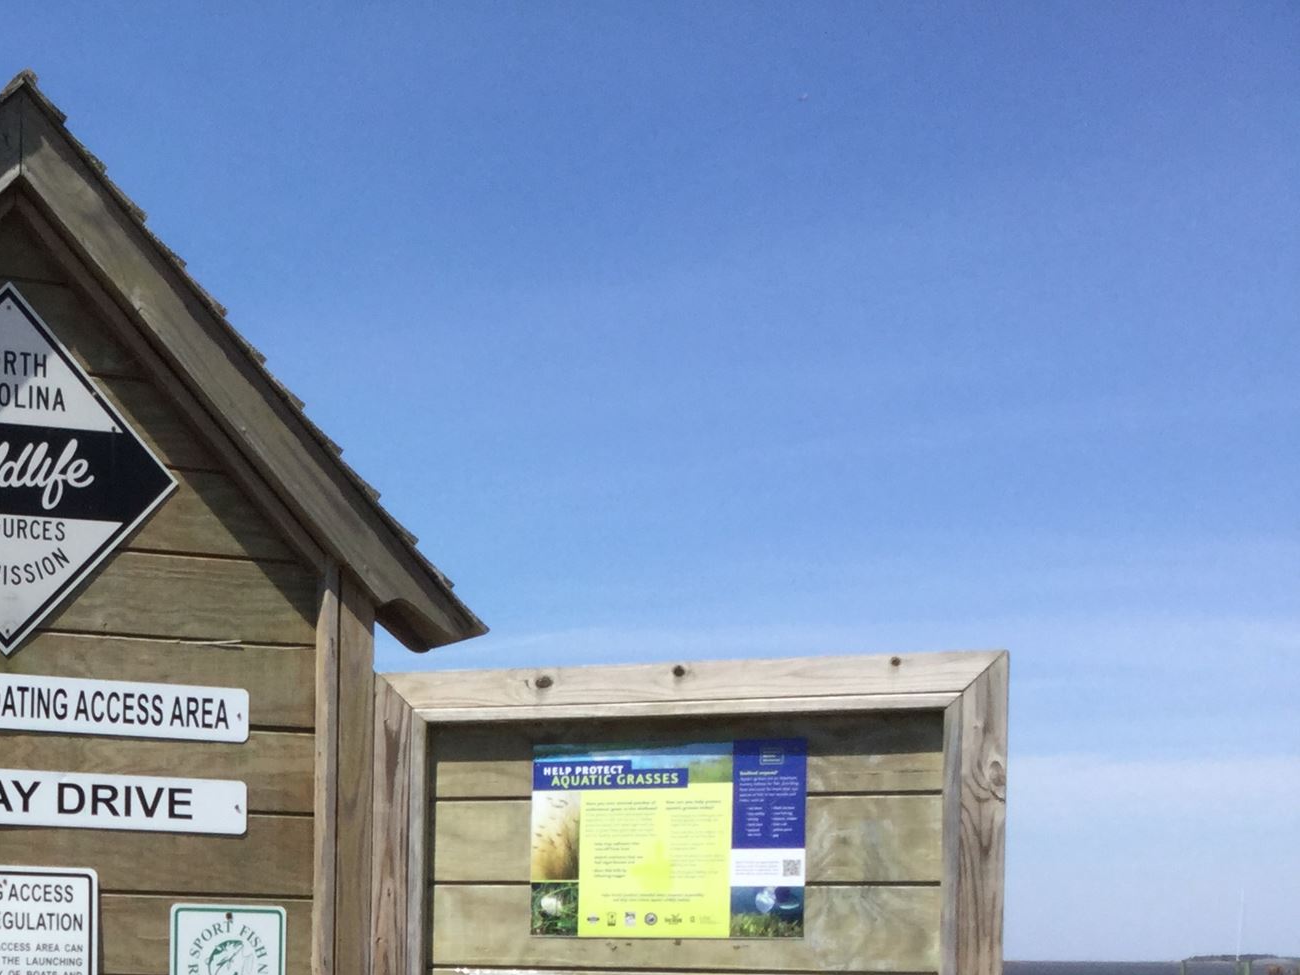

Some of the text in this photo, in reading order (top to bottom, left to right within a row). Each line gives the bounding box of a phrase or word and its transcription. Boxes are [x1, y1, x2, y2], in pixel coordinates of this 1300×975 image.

[75, 692, 164, 726] ACCESS
[170, 697, 229, 730] AREA
[544, 765, 623, 776] HELP PROTECT
[552, 773, 679, 789] AQUATIC GRASSES
[57, 782, 193, 820] DRIVE
[8, 884, 74, 903] ACCESS
[36, 943, 60, 953] AREA
[65, 944, 83, 953] CAN
[189, 920, 268, 960] SPORT FISH
[2, 956, 20, 965] THE
[26, 956, 83, 966] LAUNCHING
